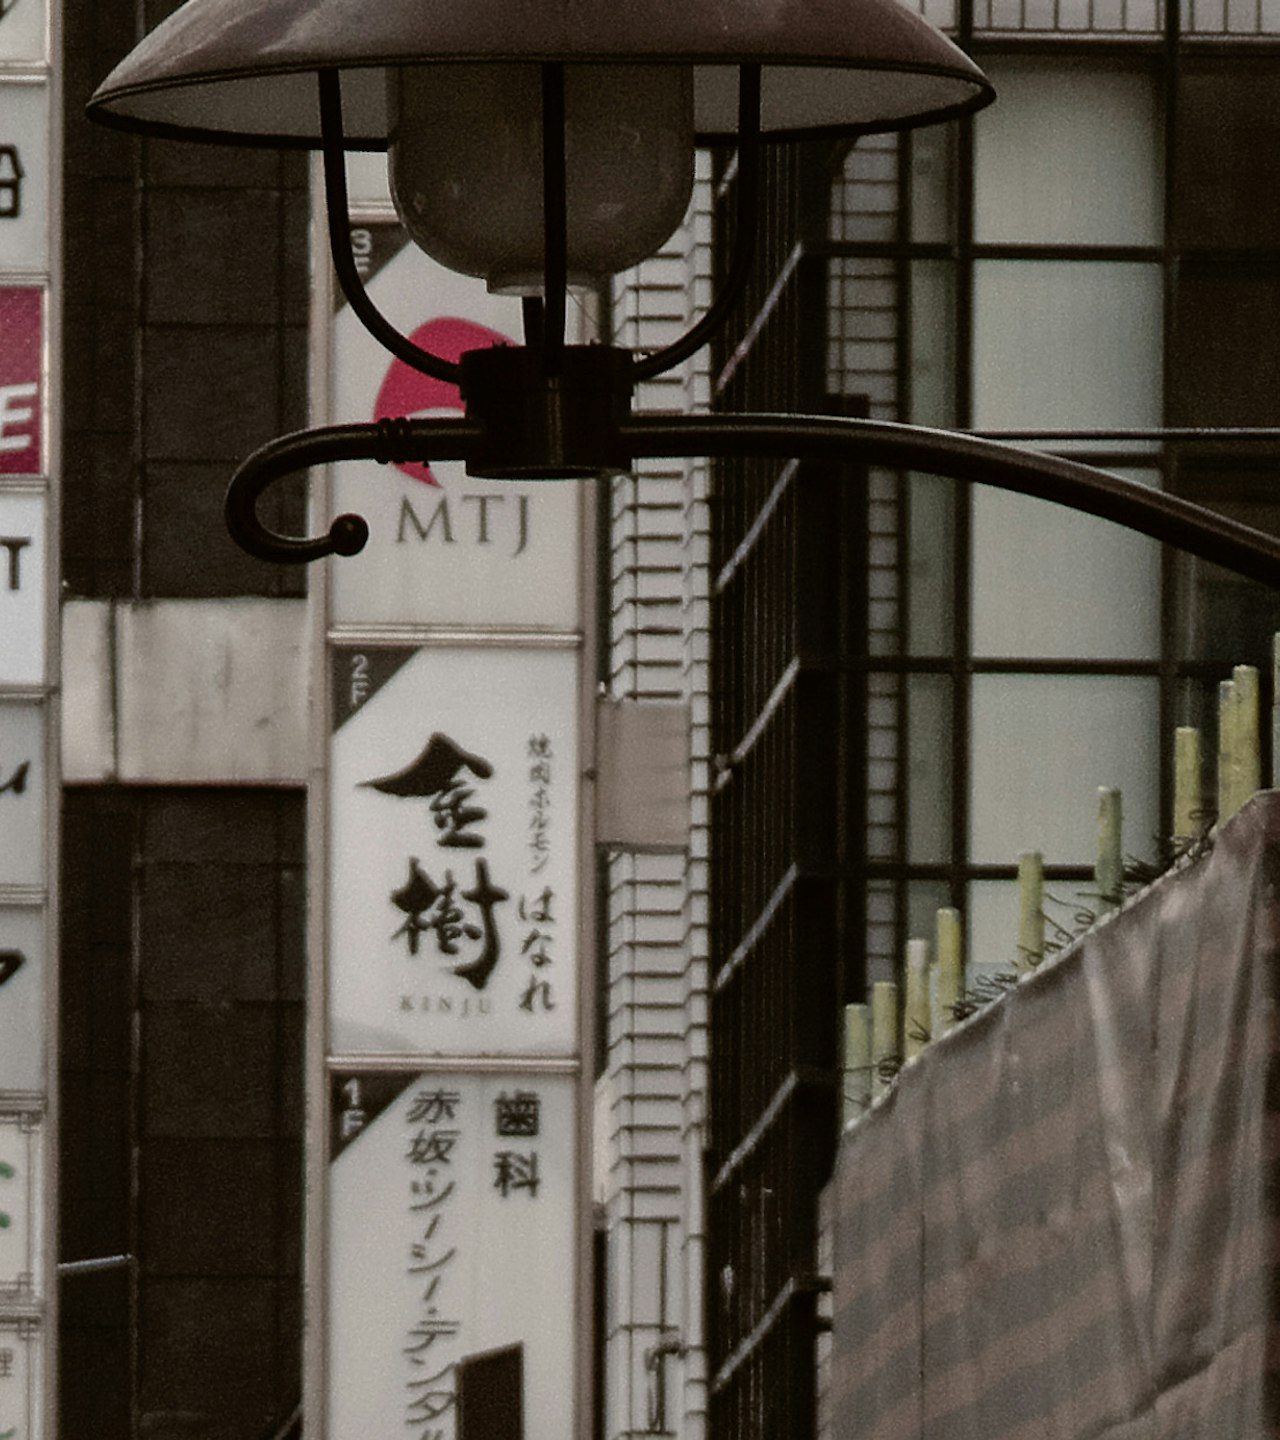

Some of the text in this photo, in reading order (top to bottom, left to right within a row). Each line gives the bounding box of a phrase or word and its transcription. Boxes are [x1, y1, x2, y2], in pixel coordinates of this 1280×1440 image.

[395, 494, 531, 557] MTJ
[351, 653, 371, 704] 2F
[519, 885, 556, 1013] はなれ
[342, 1078, 365, 1137] 1F
[493, 1088, 541, 1199] 歯科
